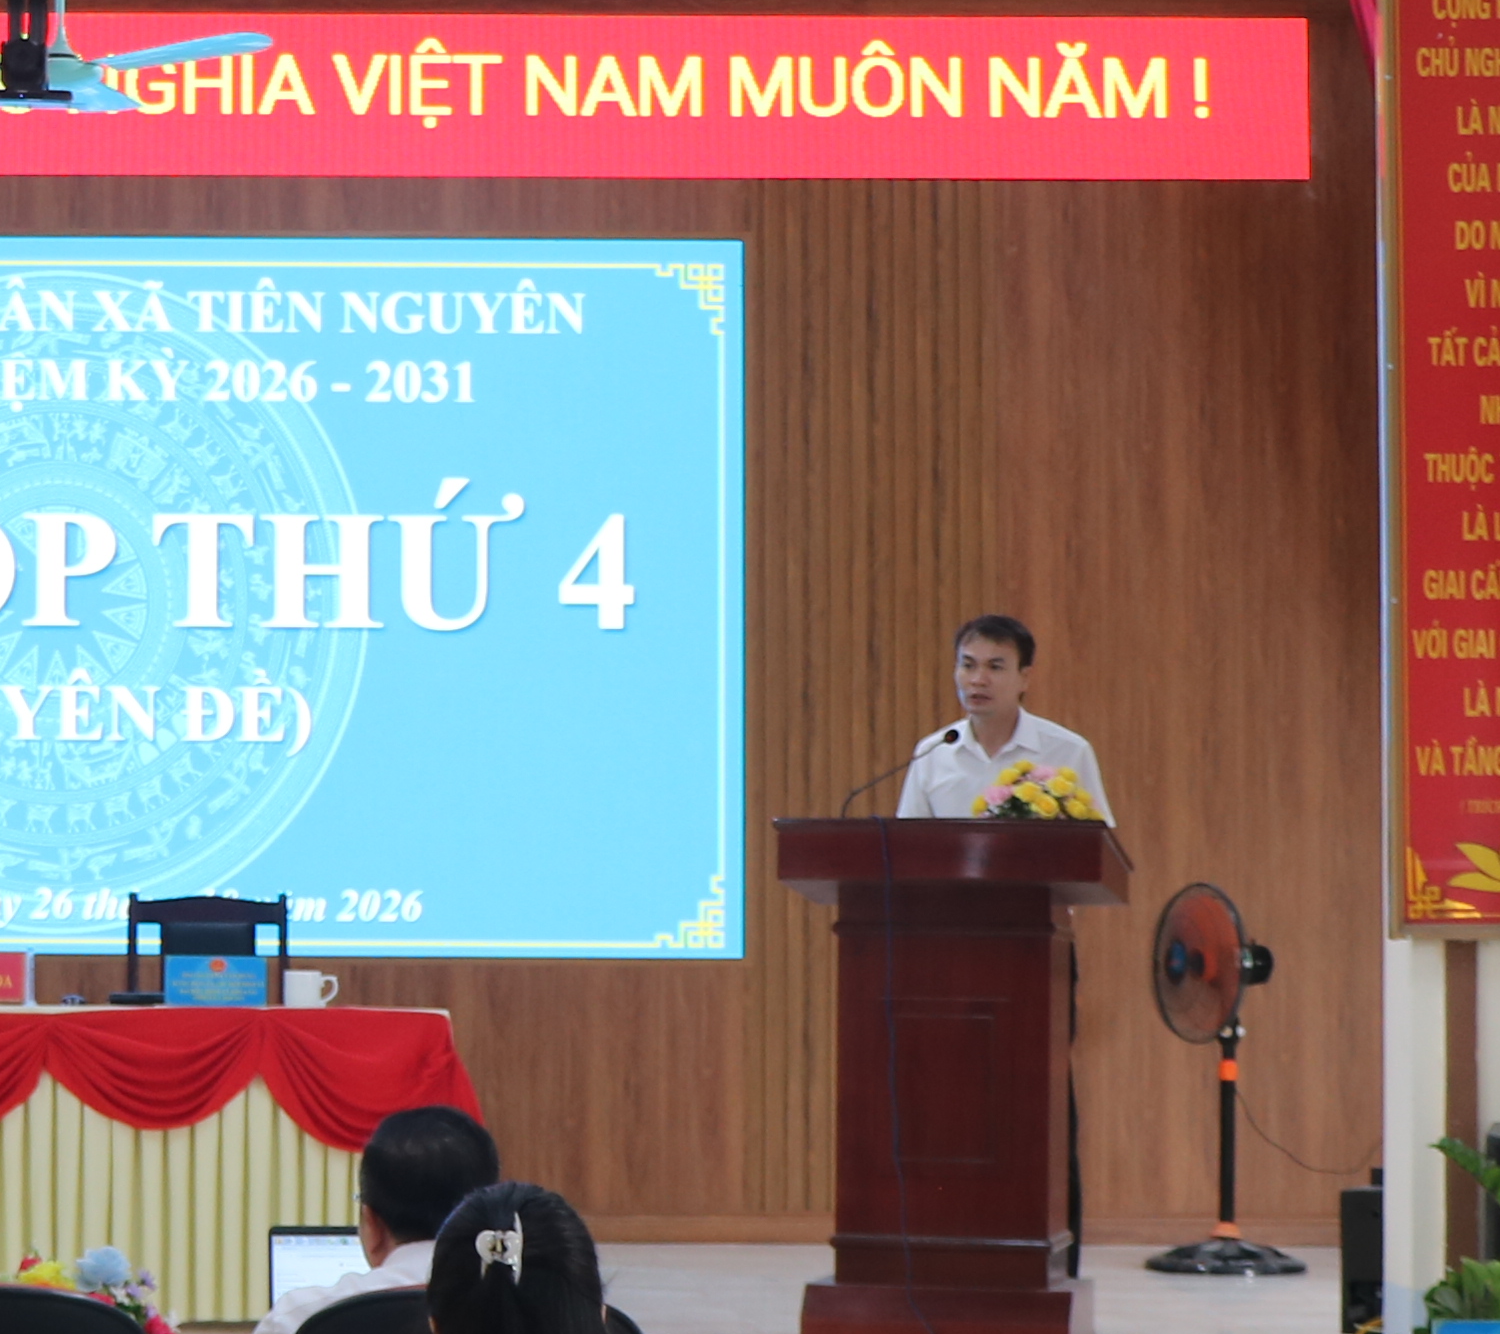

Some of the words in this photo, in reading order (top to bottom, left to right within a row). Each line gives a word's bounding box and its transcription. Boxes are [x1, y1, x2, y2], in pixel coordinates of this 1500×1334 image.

[1415, 35, 1460, 78] CHỦ
[331, 35, 505, 130] VIỆT
[524, 54, 704, 119] NAM
[729, 39, 964, 119] MUÔN
[987, 41, 1169, 120] NĂM
[1191, 56, 1212, 120] !
[1456, 98, 1485, 136] LÀ
[1447, 150, 1493, 193] CỦA
[1454, 219, 1487, 251] DO
[92, 280, 174, 333] XÃ
[186, 276, 326, 334] TIÊN
[340, 277, 587, 335] NGUYÊN
[1464, 271, 1487, 309] VÌ
[1427, 326, 1470, 367] TẤT
[106, 345, 186, 403] KỲ
[204, 358, 320, 404] 2026
[365, 359, 477, 404] 2031
[1423, 446, 1495, 491] THUỘC
[1461, 503, 1490, 542] LÀ
[152, 476, 527, 633] THỨ
[557, 512, 637, 632] 4
[1422, 568, 1467, 601] GIAI
[1452, 628, 1497, 660] GIAI
[182, 670, 314, 758] ĐỀ)
[1463, 679, 1492, 718] LÀ
[1415, 739, 1447, 777] VÀ
[29, 886, 76, 921] 26
[336, 888, 425, 924] 2026
